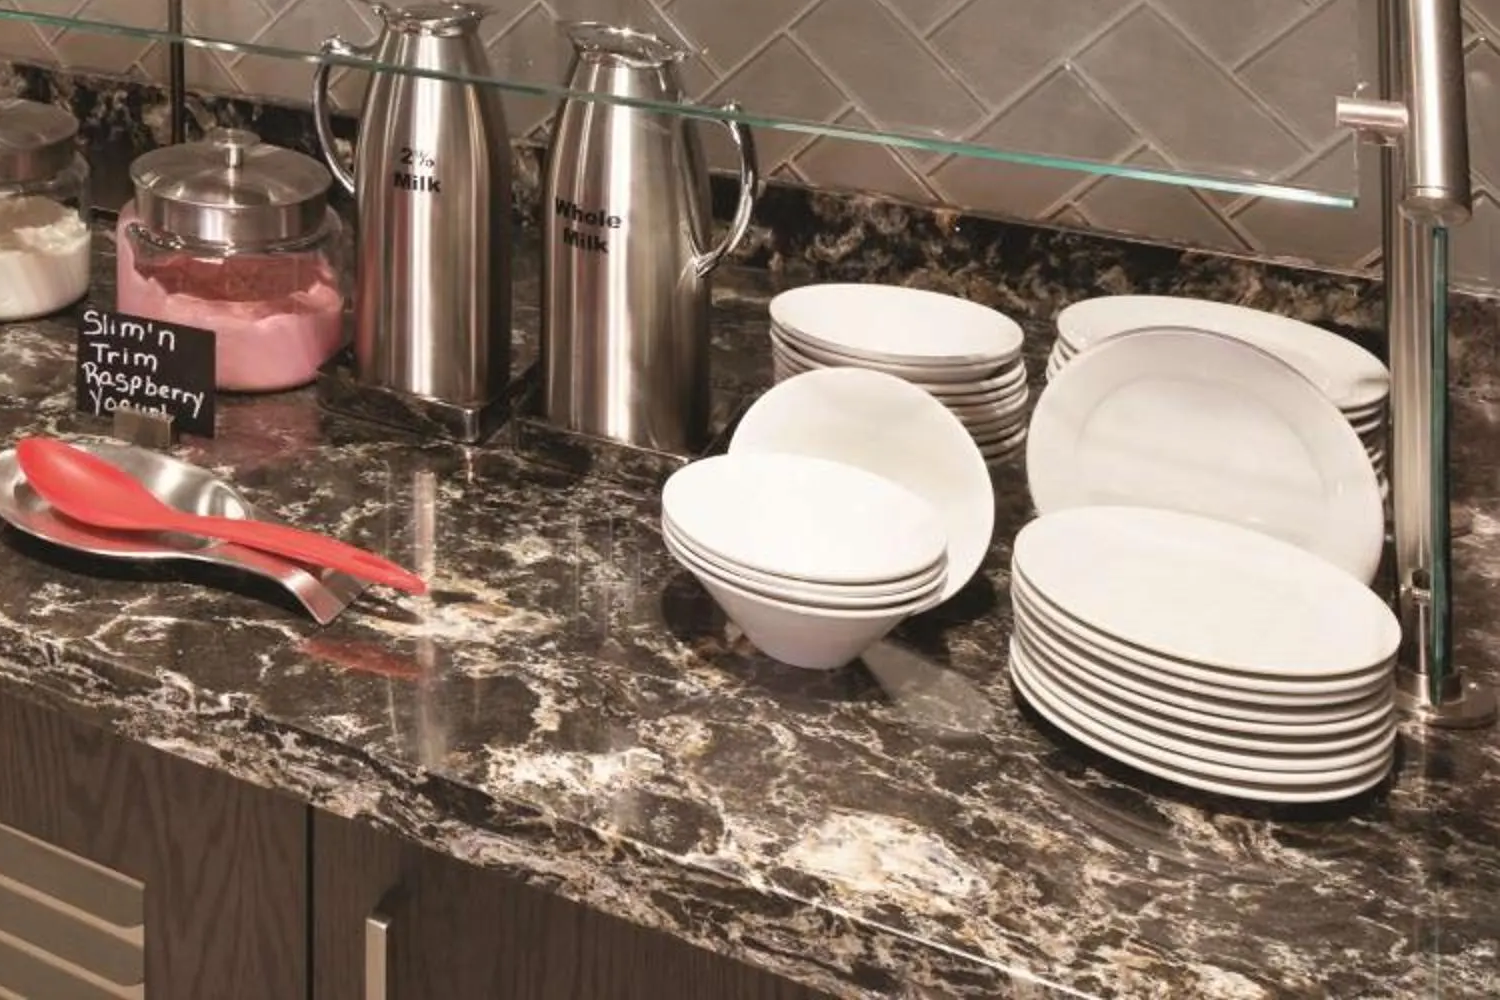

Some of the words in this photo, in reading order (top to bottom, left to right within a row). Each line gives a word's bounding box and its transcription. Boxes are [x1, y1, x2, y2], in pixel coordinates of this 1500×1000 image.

[400, 148, 435, 168] 2%
[393, 172, 441, 193] Milk
[554, 197, 622, 229] Whole
[563, 227, 608, 253] Milk
[83, 309, 175, 352] Slim'n
[90, 343, 158, 372] Trim
[81, 361, 204, 419] Raspberry
